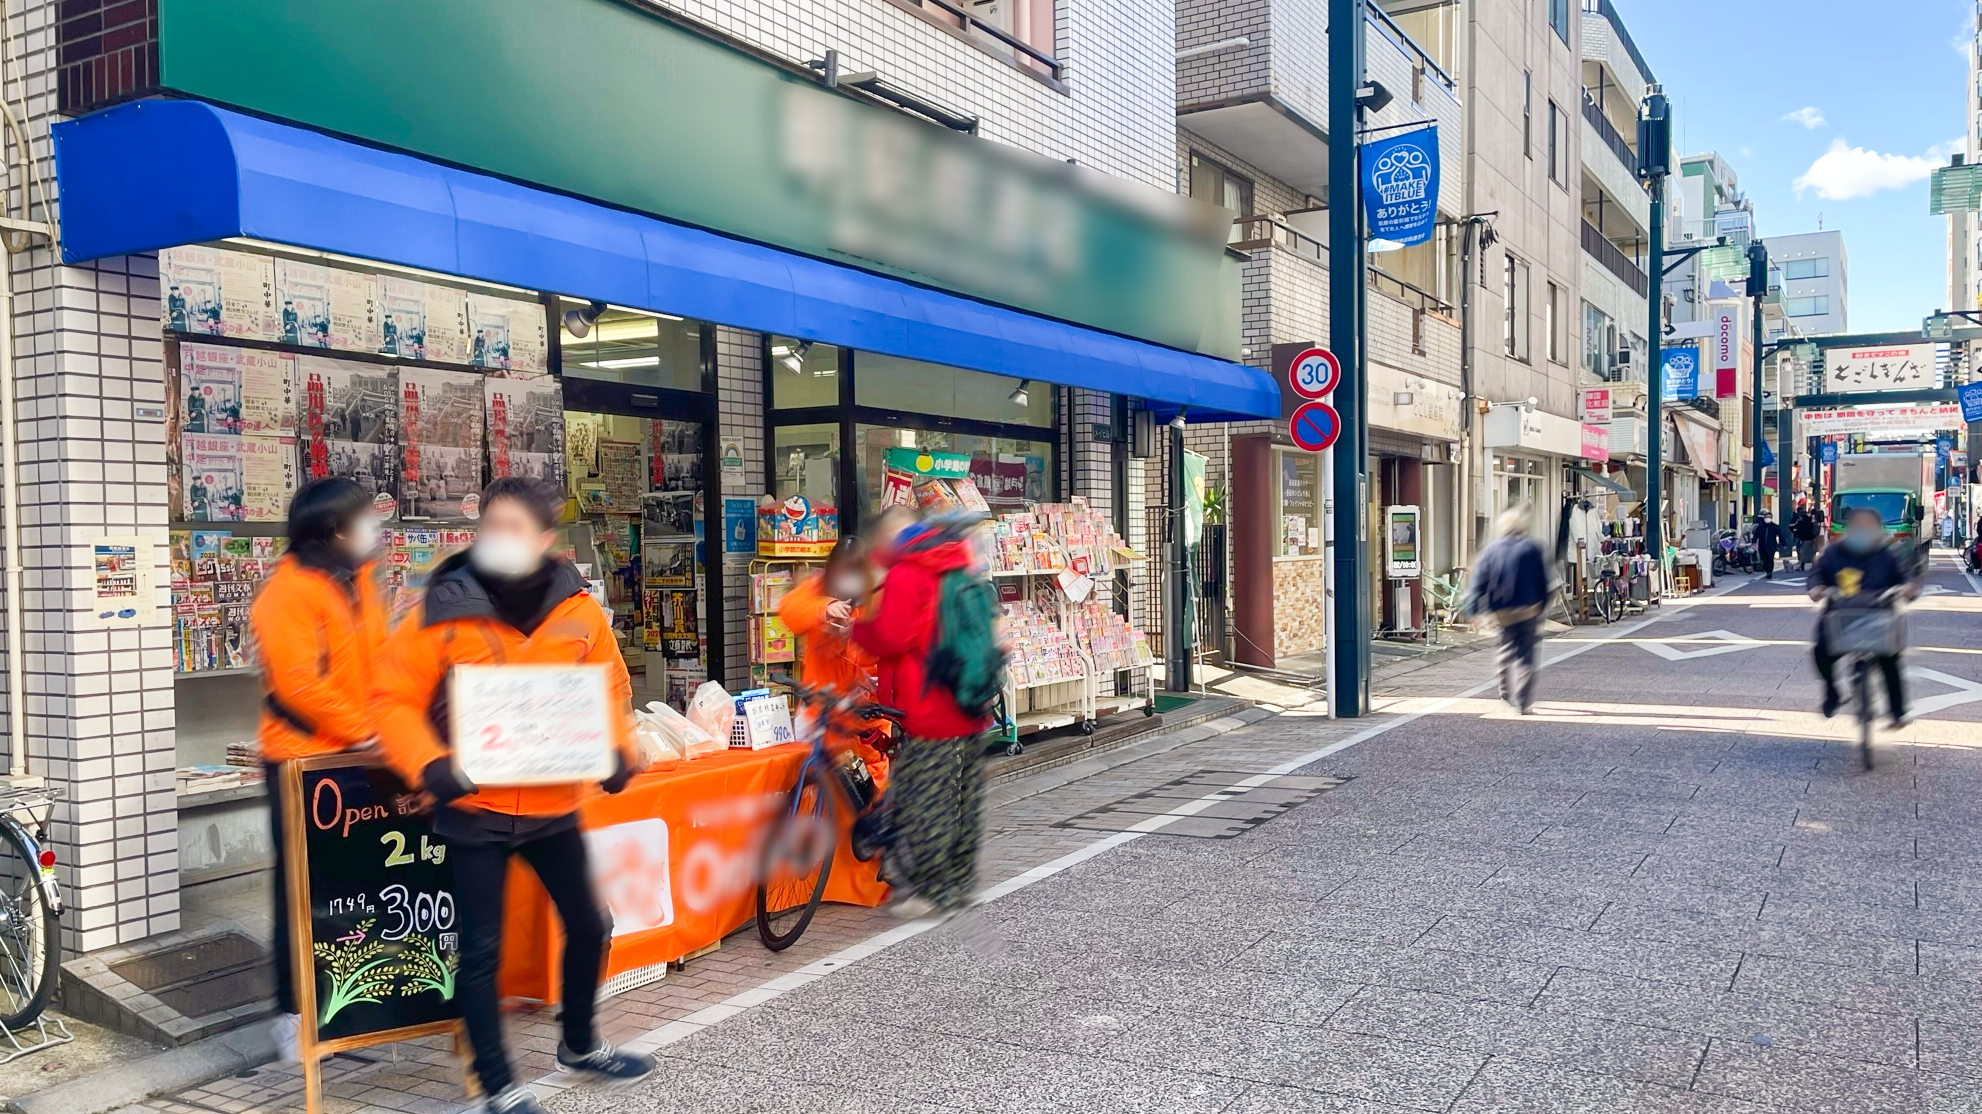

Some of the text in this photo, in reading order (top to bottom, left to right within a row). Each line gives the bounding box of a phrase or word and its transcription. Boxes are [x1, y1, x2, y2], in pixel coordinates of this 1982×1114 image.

[1384, 180, 1423, 194] #MAKE
[1384, 189, 1422, 203] ITBLUE
[1377, 199, 1431, 219] ありがとう!
[263, 282, 271, 308] 町中華
[1721, 316, 1731, 361] docomo
[1301, 362, 1329, 385] 30
[1834, 360, 1927, 384] とごしぎんざ
[283, 379, 292, 405] 町中華
[284, 464, 293, 489] 町中華
[408, 534, 428, 544] サバ缶
[228, 607, 251, 617] 週刊文
[313, 778, 389, 837] Open
[380, 830, 446, 868] 2 kg
